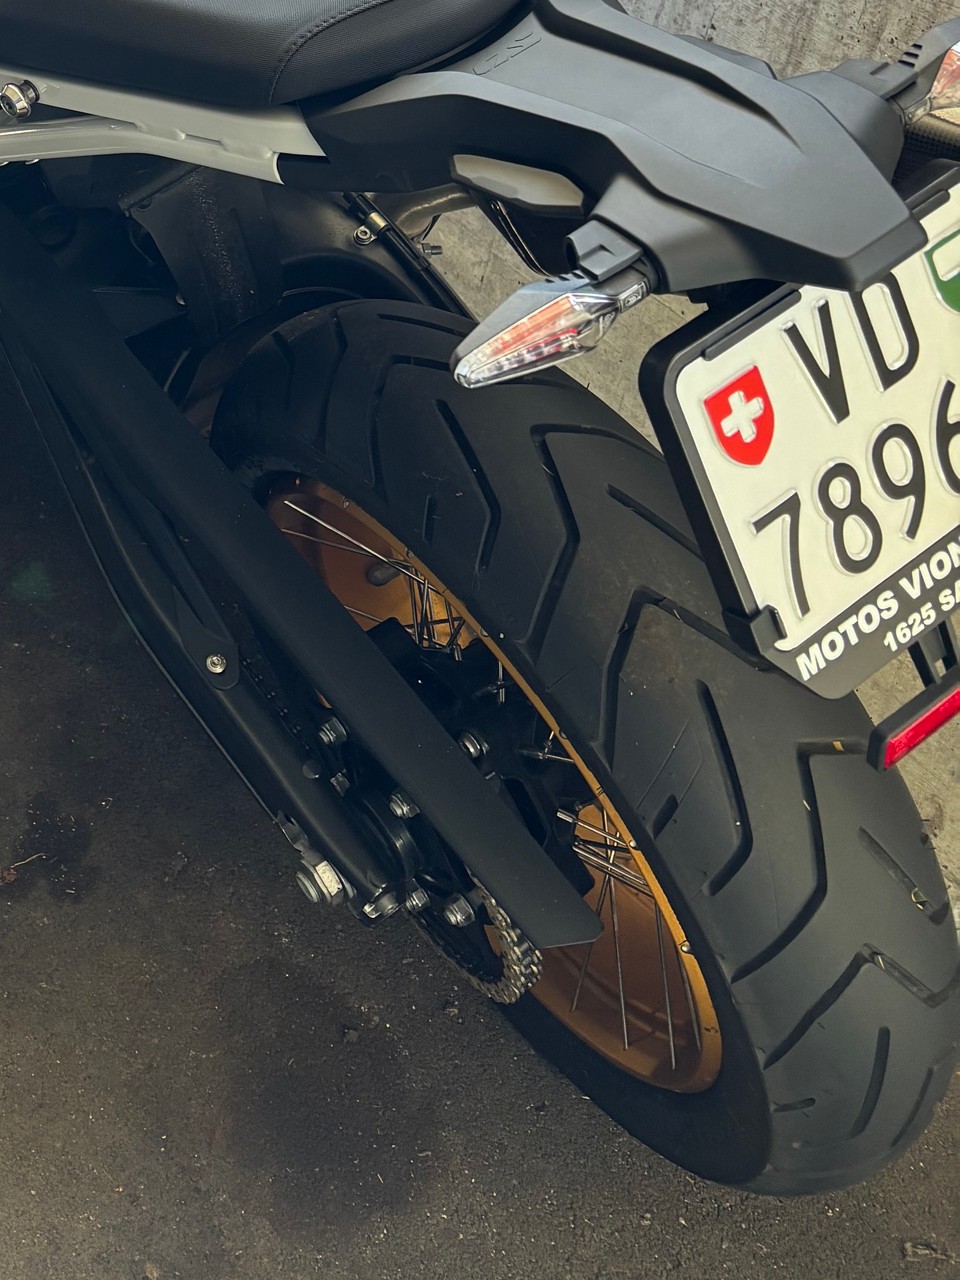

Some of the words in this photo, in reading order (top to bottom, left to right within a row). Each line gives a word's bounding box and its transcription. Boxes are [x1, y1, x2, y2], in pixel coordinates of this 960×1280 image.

[783, 271, 920, 424] VD
[795, 590, 899, 682] MOTOS
[883, 602, 937, 652] 1625
